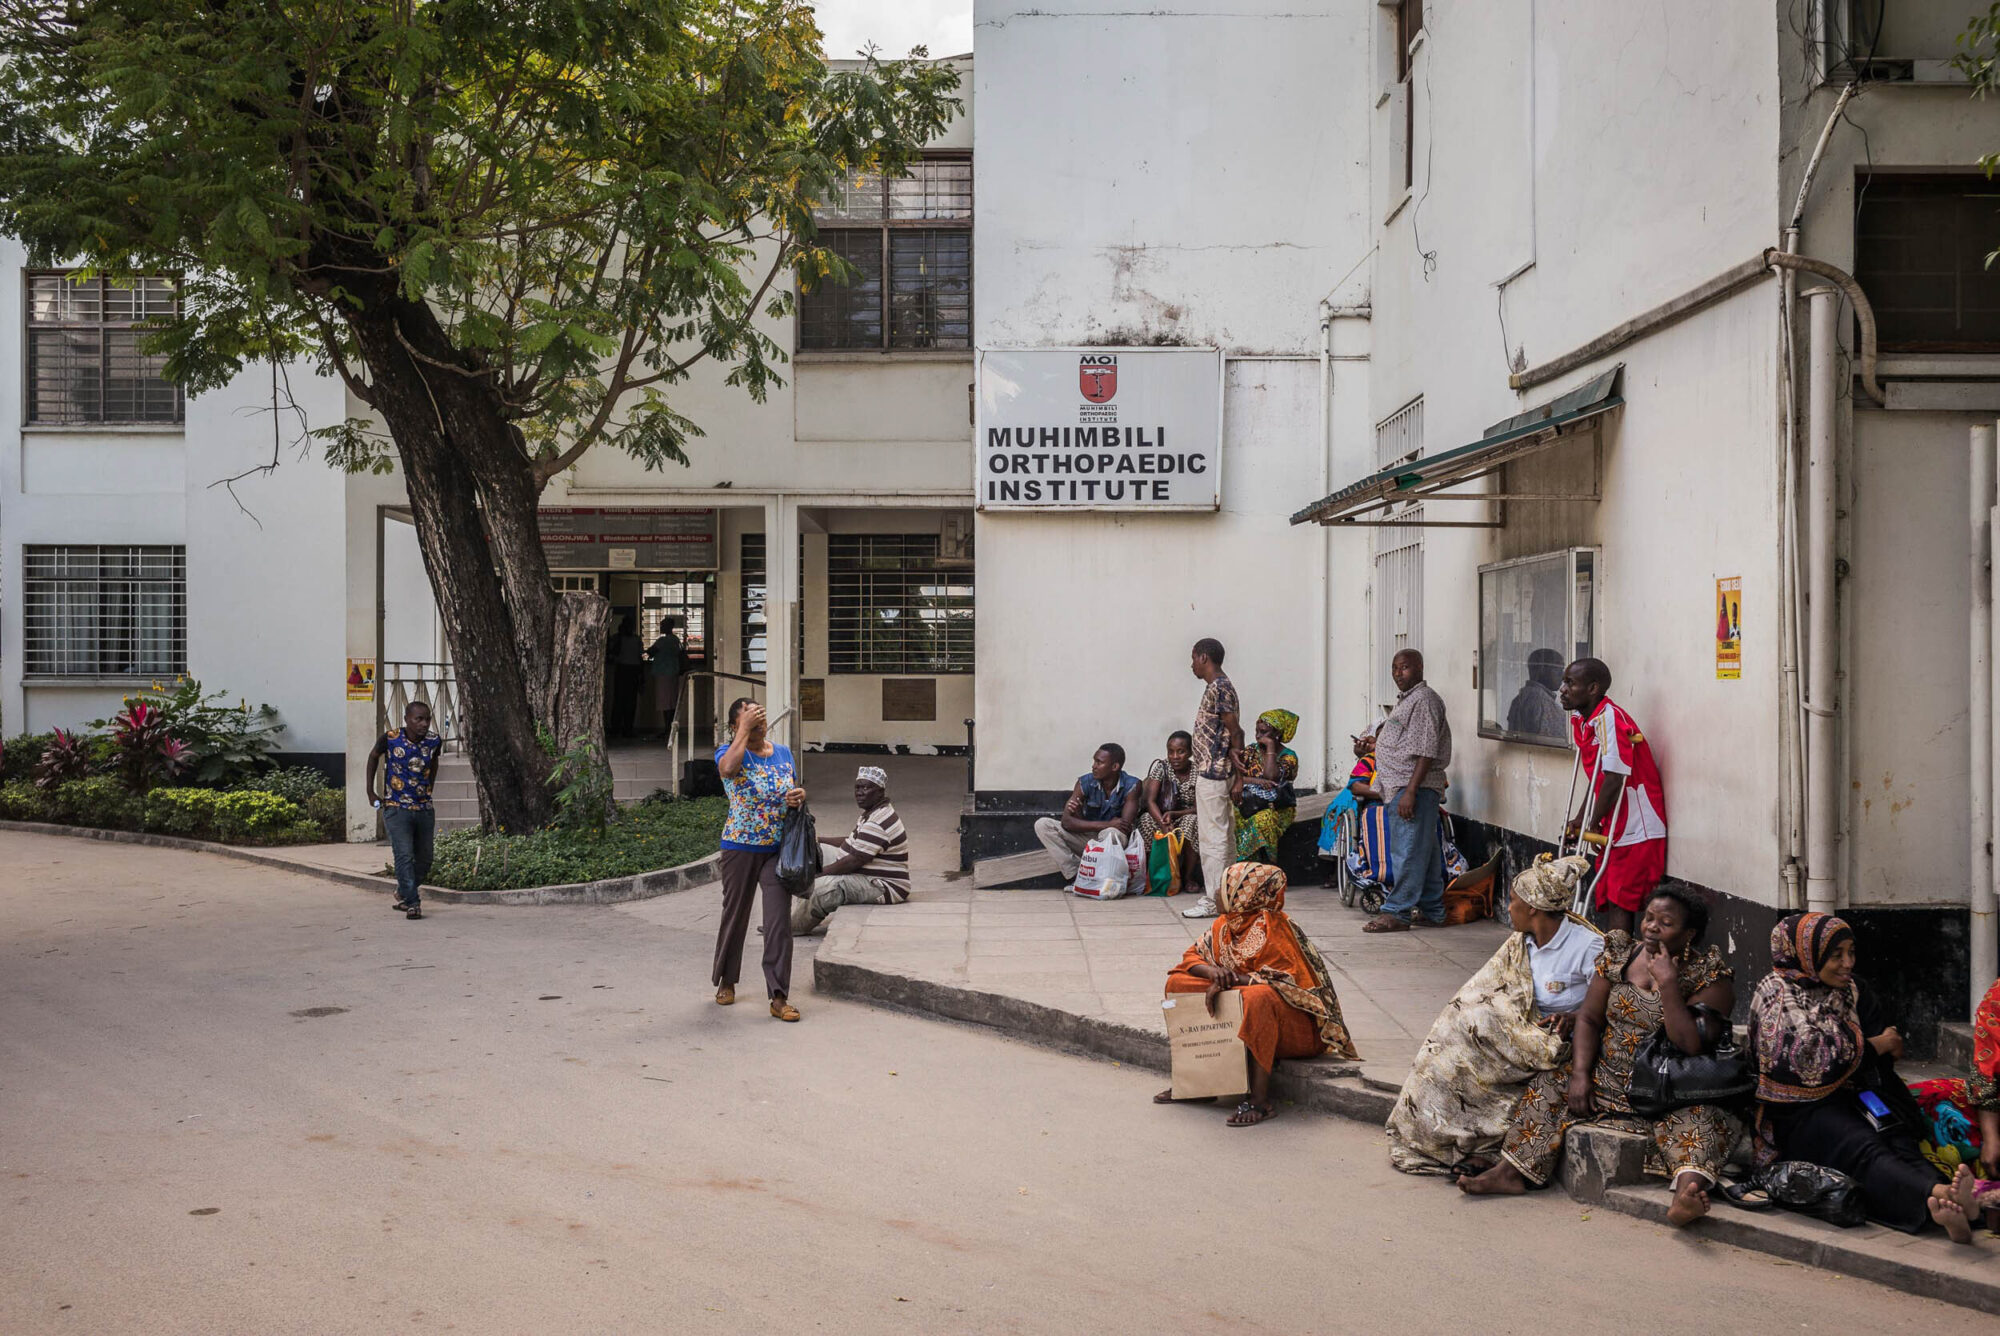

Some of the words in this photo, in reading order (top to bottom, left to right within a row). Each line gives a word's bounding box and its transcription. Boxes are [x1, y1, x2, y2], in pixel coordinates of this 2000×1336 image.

[1080, 356, 1117, 364] MOI
[988, 427, 1165, 447] MUHIMBILI
[988, 453, 1207, 474] ORTHOPAEDIC
[988, 480, 1170, 501] INSTITUTE
[1200, 1022, 1233, 1031] DEPARTMENT
